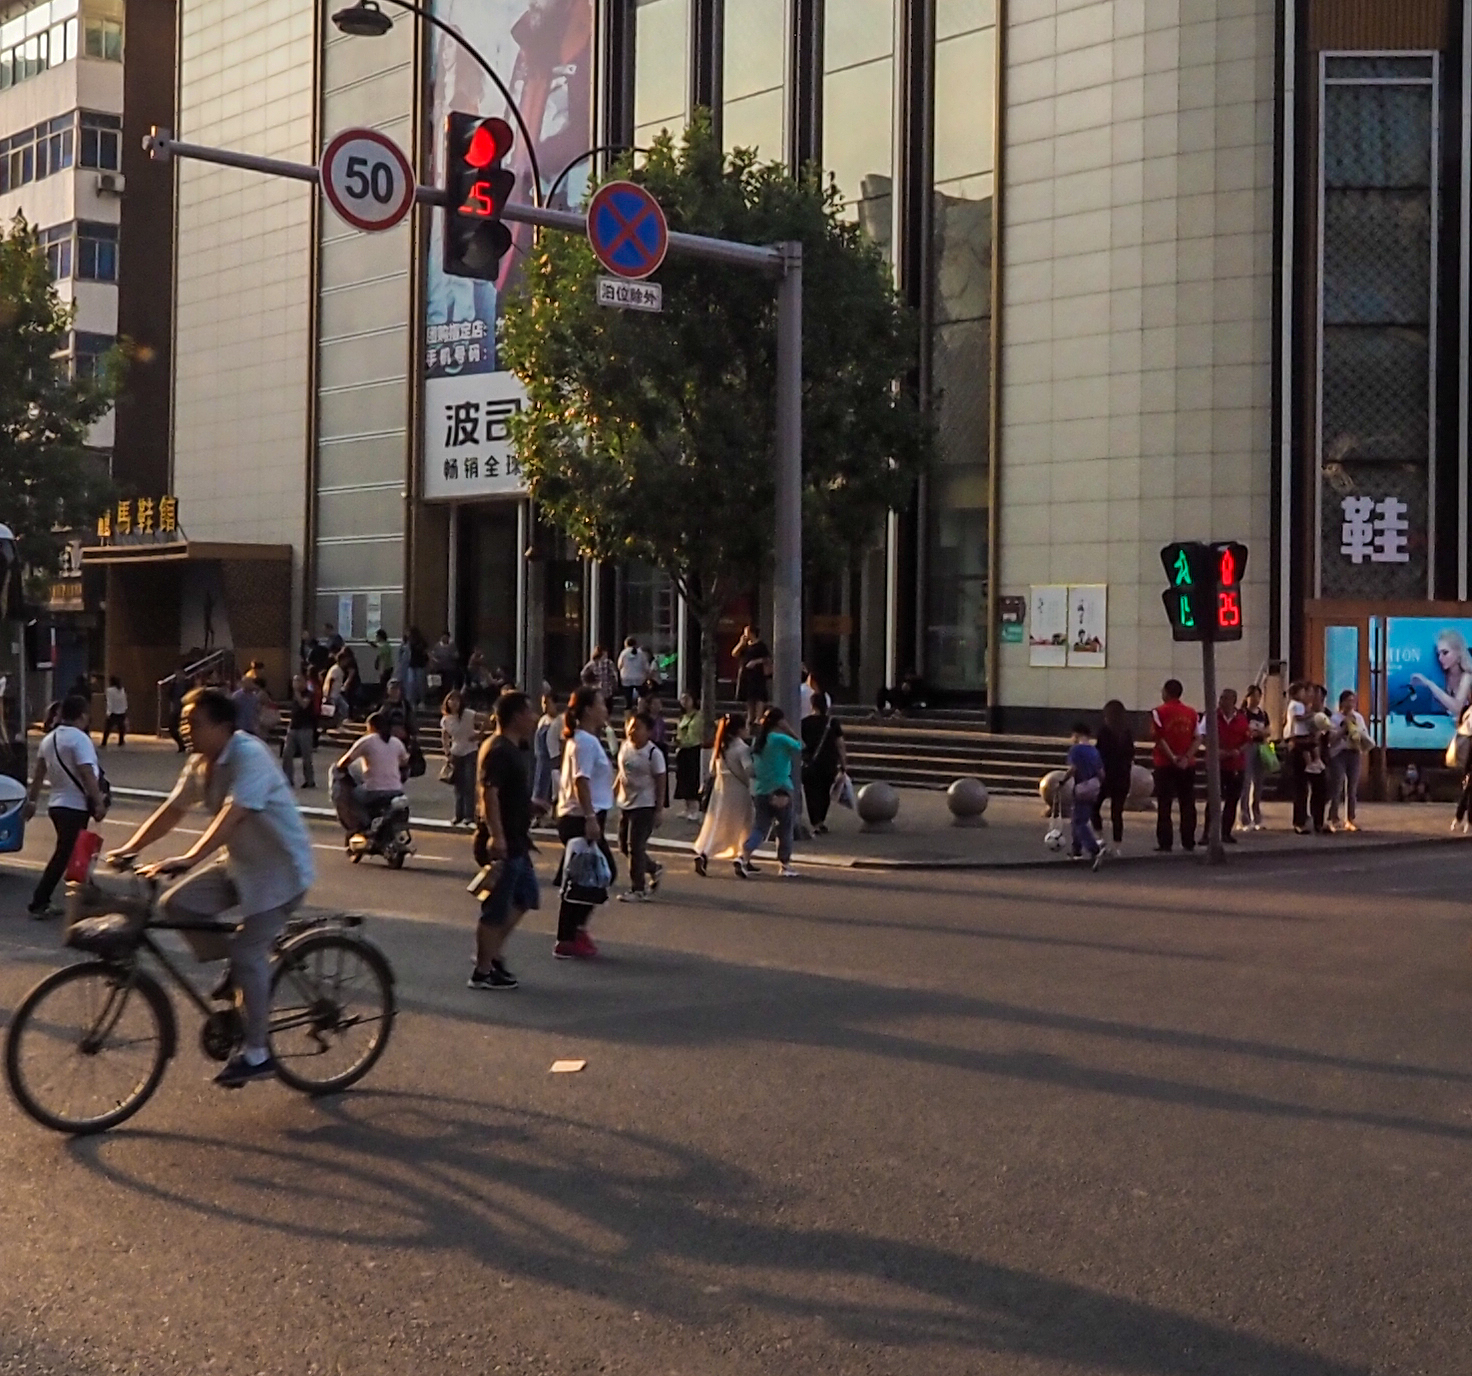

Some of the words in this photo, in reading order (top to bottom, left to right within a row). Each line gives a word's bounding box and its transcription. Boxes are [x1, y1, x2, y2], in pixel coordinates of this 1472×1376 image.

[345, 156, 394, 204] 50
[601, 284, 658, 306] 泊位除外
